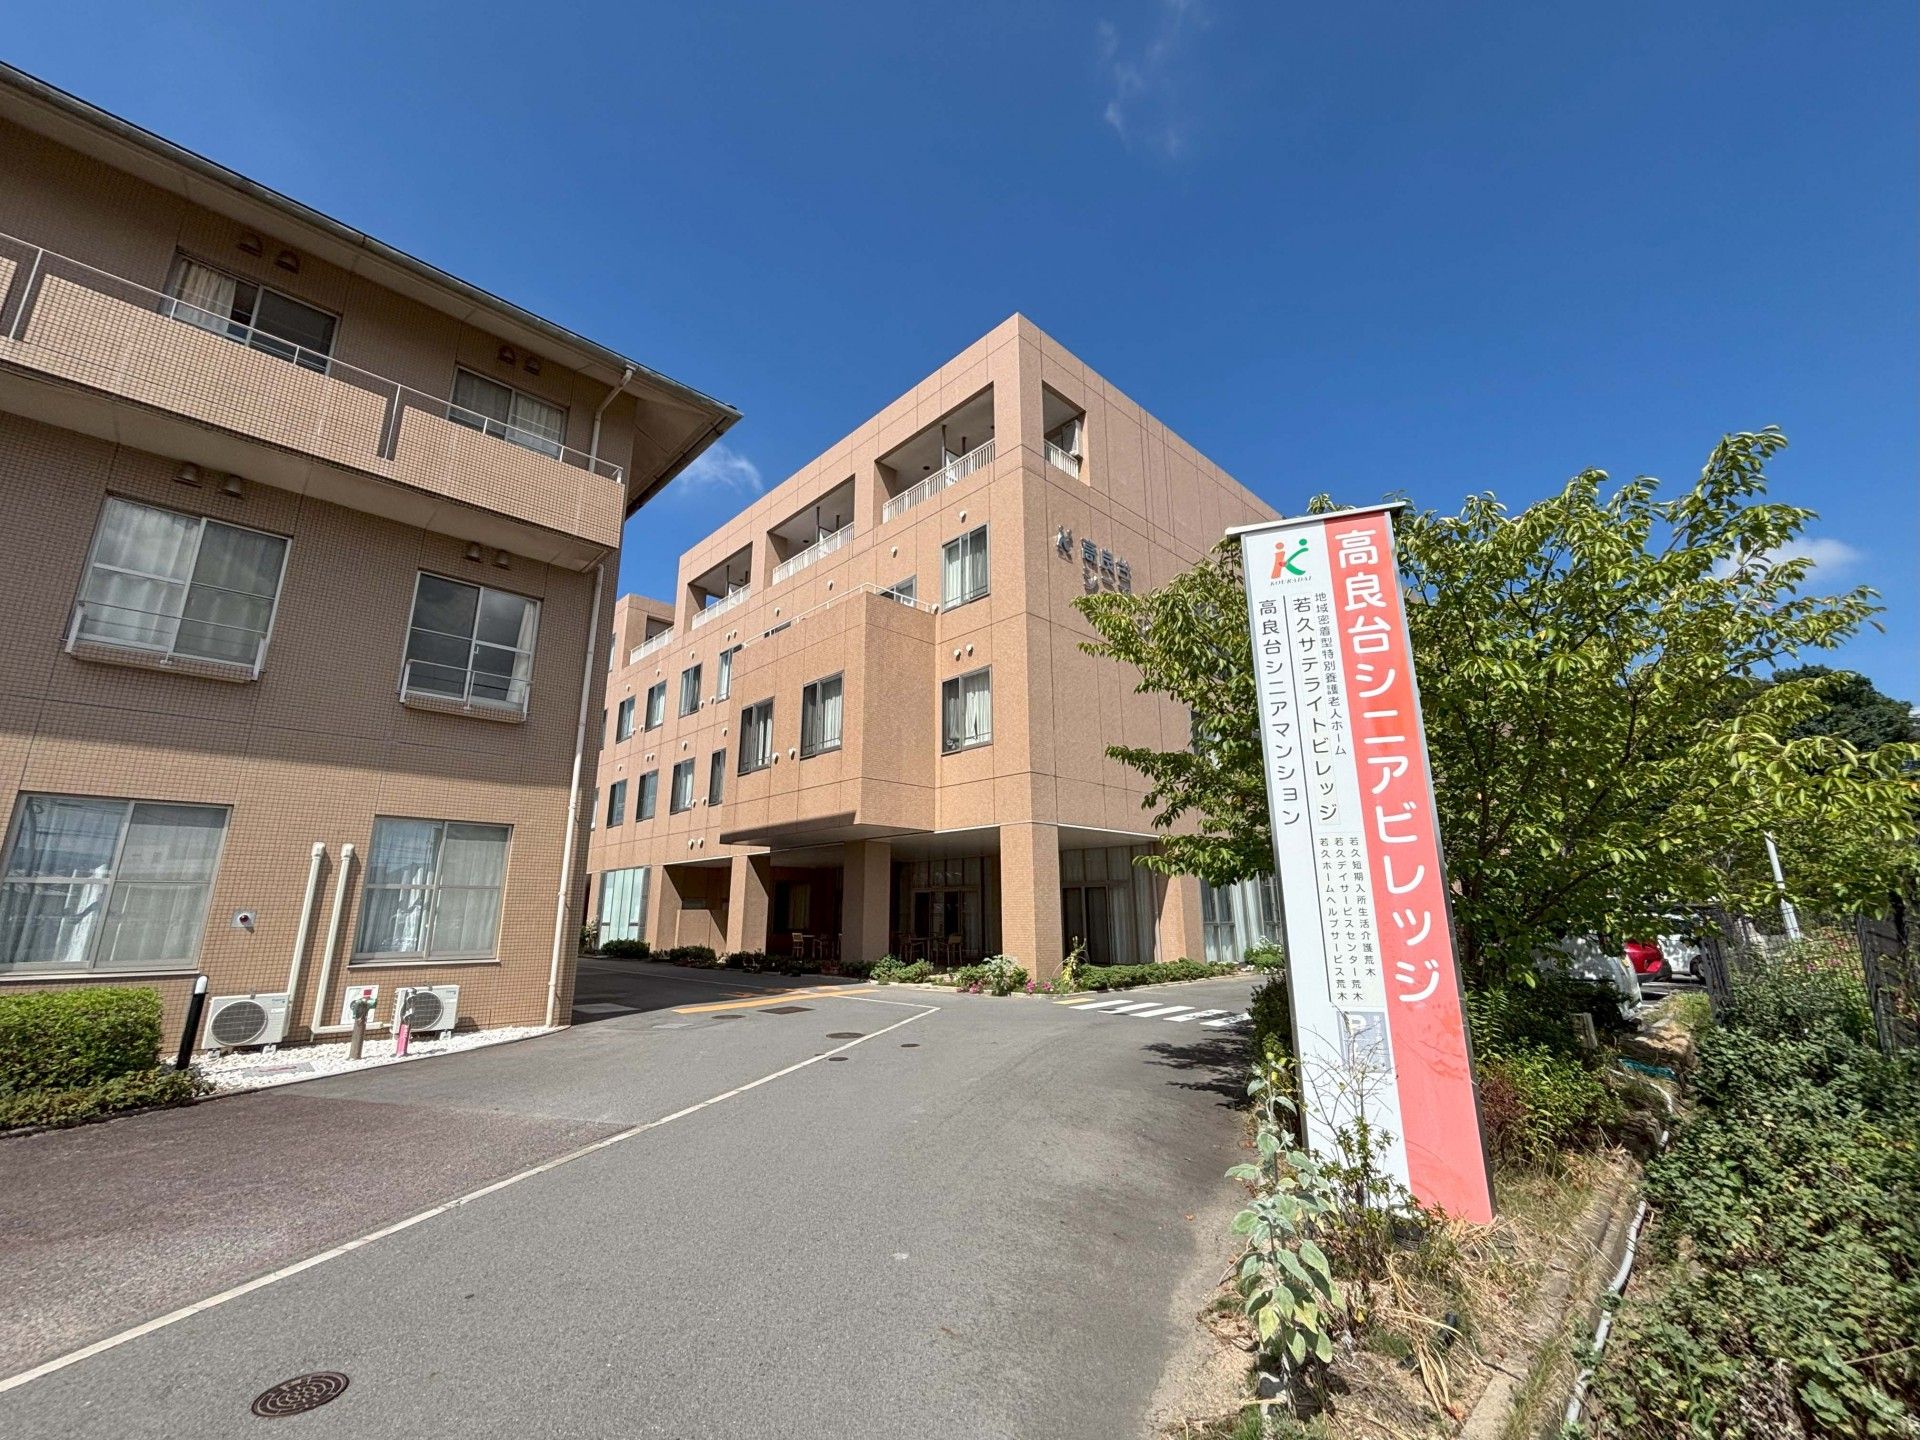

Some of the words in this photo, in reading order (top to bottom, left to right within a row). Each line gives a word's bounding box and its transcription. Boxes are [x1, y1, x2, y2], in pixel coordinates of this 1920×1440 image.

[1259, 599, 1300, 825] 高良台シニアマンション
[1293, 597, 1337, 820] 若久サテライトビレッジ
[1314, 592, 1347, 756] 地域密着型特別養護老人ホーム
[1335, 529, 1440, 1003] 高良台シニアビレッジ
